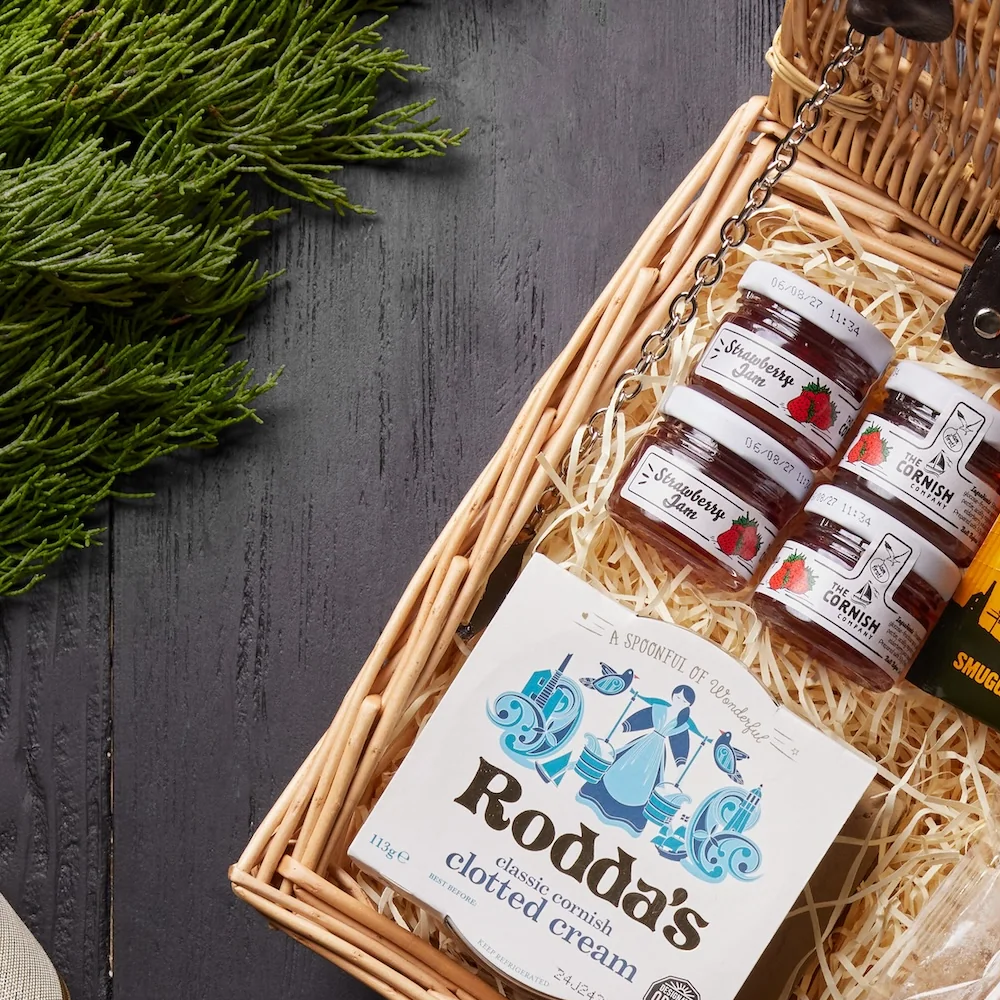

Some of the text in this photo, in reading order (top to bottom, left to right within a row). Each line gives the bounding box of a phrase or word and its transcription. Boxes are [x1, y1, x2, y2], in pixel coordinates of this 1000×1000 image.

[770, 277, 861, 337] 06/08/27 11:34
[724, 339, 794, 389] Strawberry
[731, 363, 767, 388] Jam
[745, 437, 795, 474] 06/08/27
[904, 452, 923, 467] THE
[653, 467, 726, 522] Strawberry
[896, 460, 956, 504] CORNISH
[910, 483, 949, 510] COMPANY
[662, 493, 698, 520] Jam
[841, 503, 871, 528] 11:34
[831, 582, 849, 597] THE
[822, 590, 881, 635] CORNISH
[837, 613, 873, 640] COMPANY
[609, 630, 770, 744] A SPOONFUL OF Wonderful
[453, 756, 710, 951] Rodda's
[428, 872, 478, 907] BEST BEFORE:
[495, 856, 613, 938] classic cornish
[445, 851, 638, 983] clotted cream
[477, 938, 550, 987] KEEP REFRIGERATED
